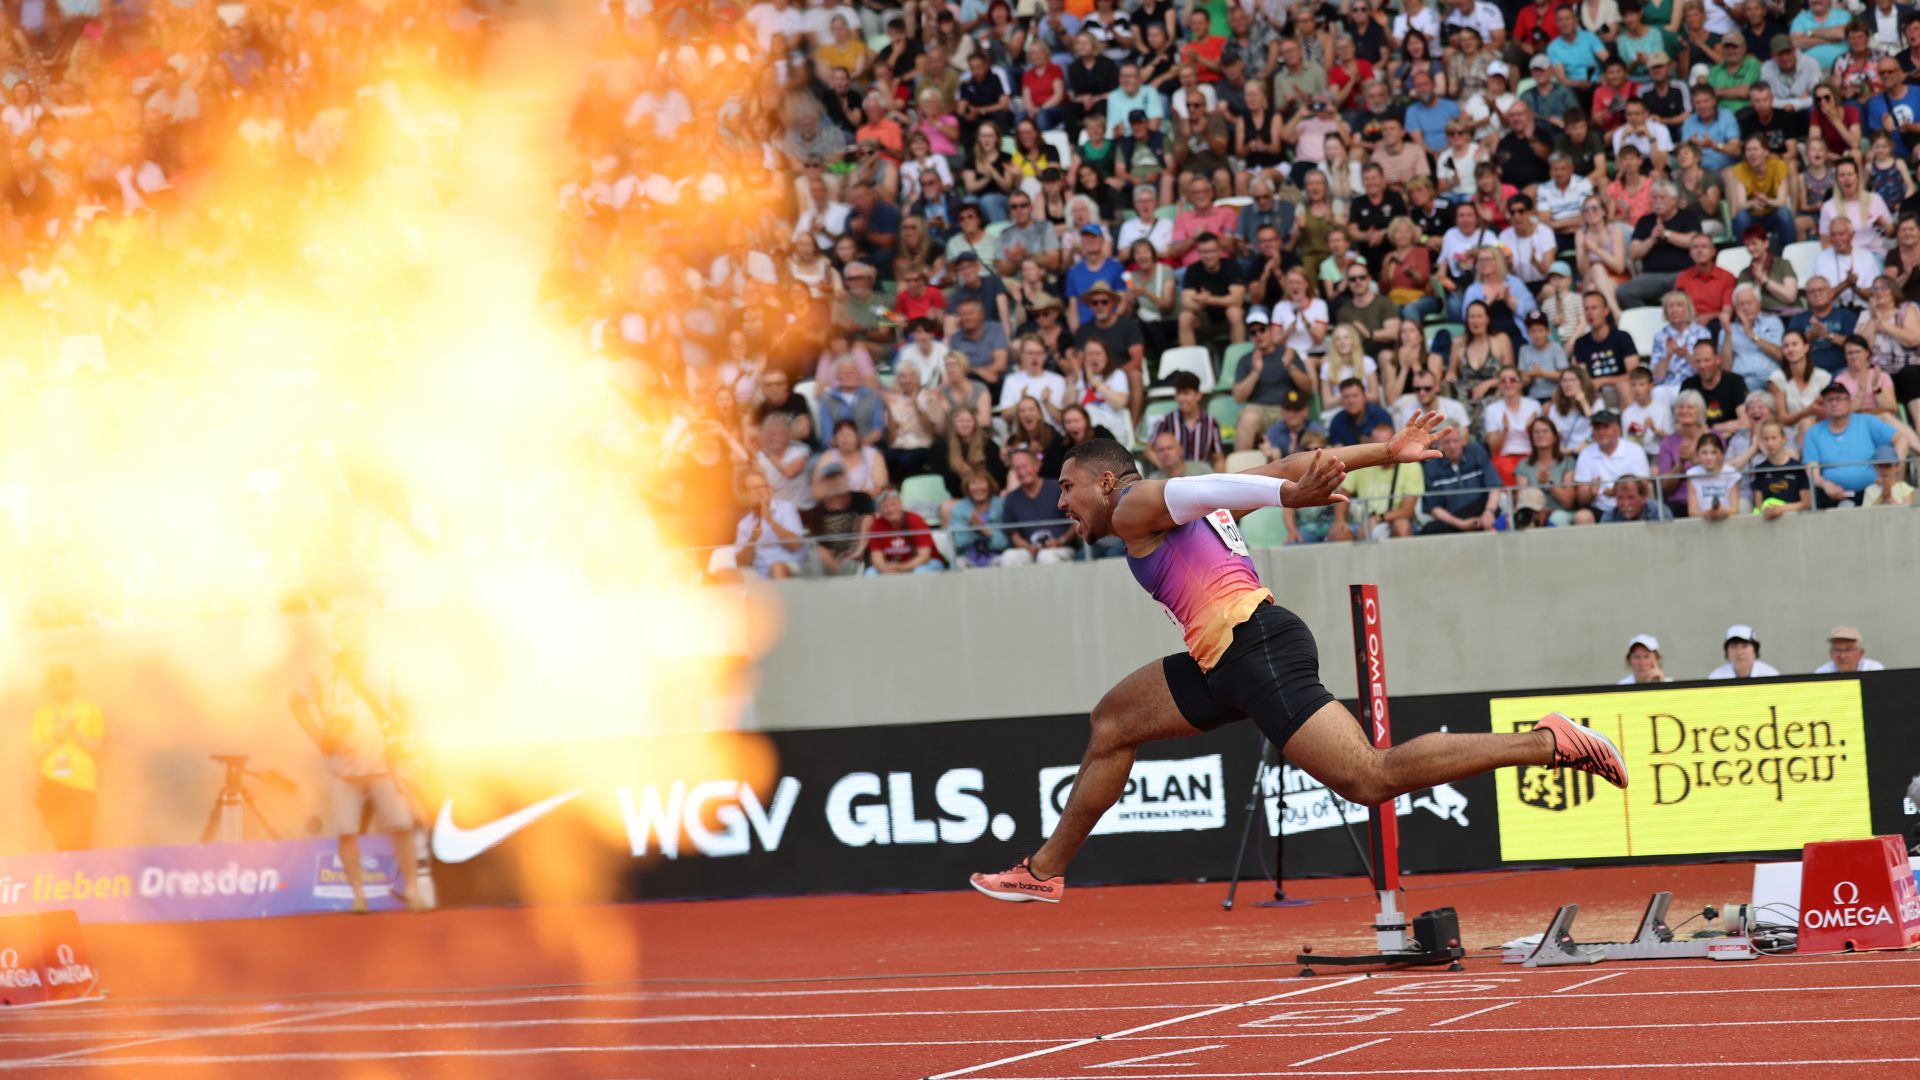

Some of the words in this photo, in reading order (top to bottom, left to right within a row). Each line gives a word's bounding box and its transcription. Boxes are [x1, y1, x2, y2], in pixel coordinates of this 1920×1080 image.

[1369, 633, 1386, 742] OMEGA
[1647, 706, 1846, 755] Dresden.
[1119, 773, 1212, 804] PLAN
[616, 776, 801, 860] WGV
[825, 767, 1016, 847] GLS.
[1119, 808, 1213, 820] INTERNATIONAL
[0, 875, 26, 904] ir
[33, 868, 131, 902] lieben
[1000, 881, 1018, 889] new
[1019, 881, 1053, 893] balance
[1803, 905, 1894, 929] OMEGA
